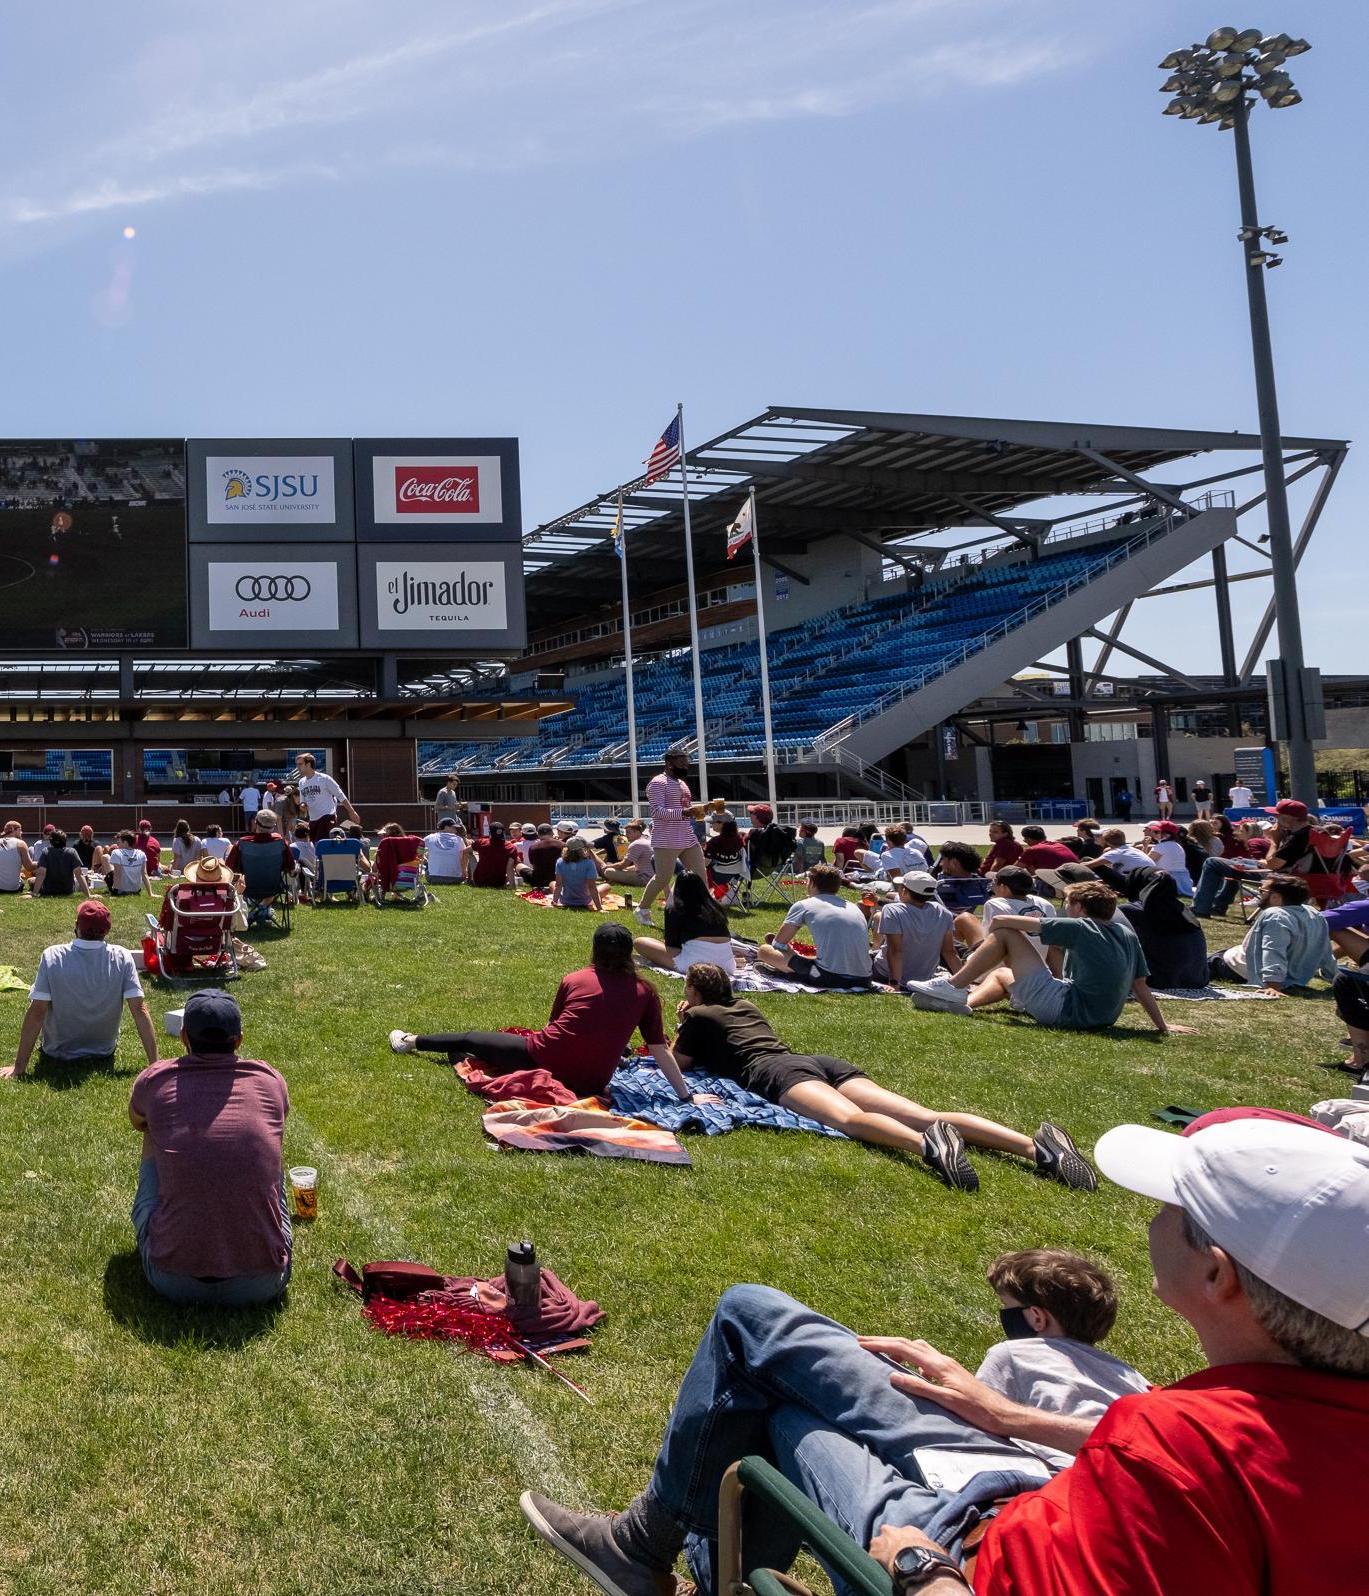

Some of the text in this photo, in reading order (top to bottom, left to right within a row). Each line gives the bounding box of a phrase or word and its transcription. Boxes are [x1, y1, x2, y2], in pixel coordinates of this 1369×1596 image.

[255, 474, 319, 502] SJSU
[399, 477, 475, 502] Coca-Cola
[279, 503, 320, 511] UNIVERSITY
[388, 577, 399, 594] el
[238, 608, 271, 618] Audi
